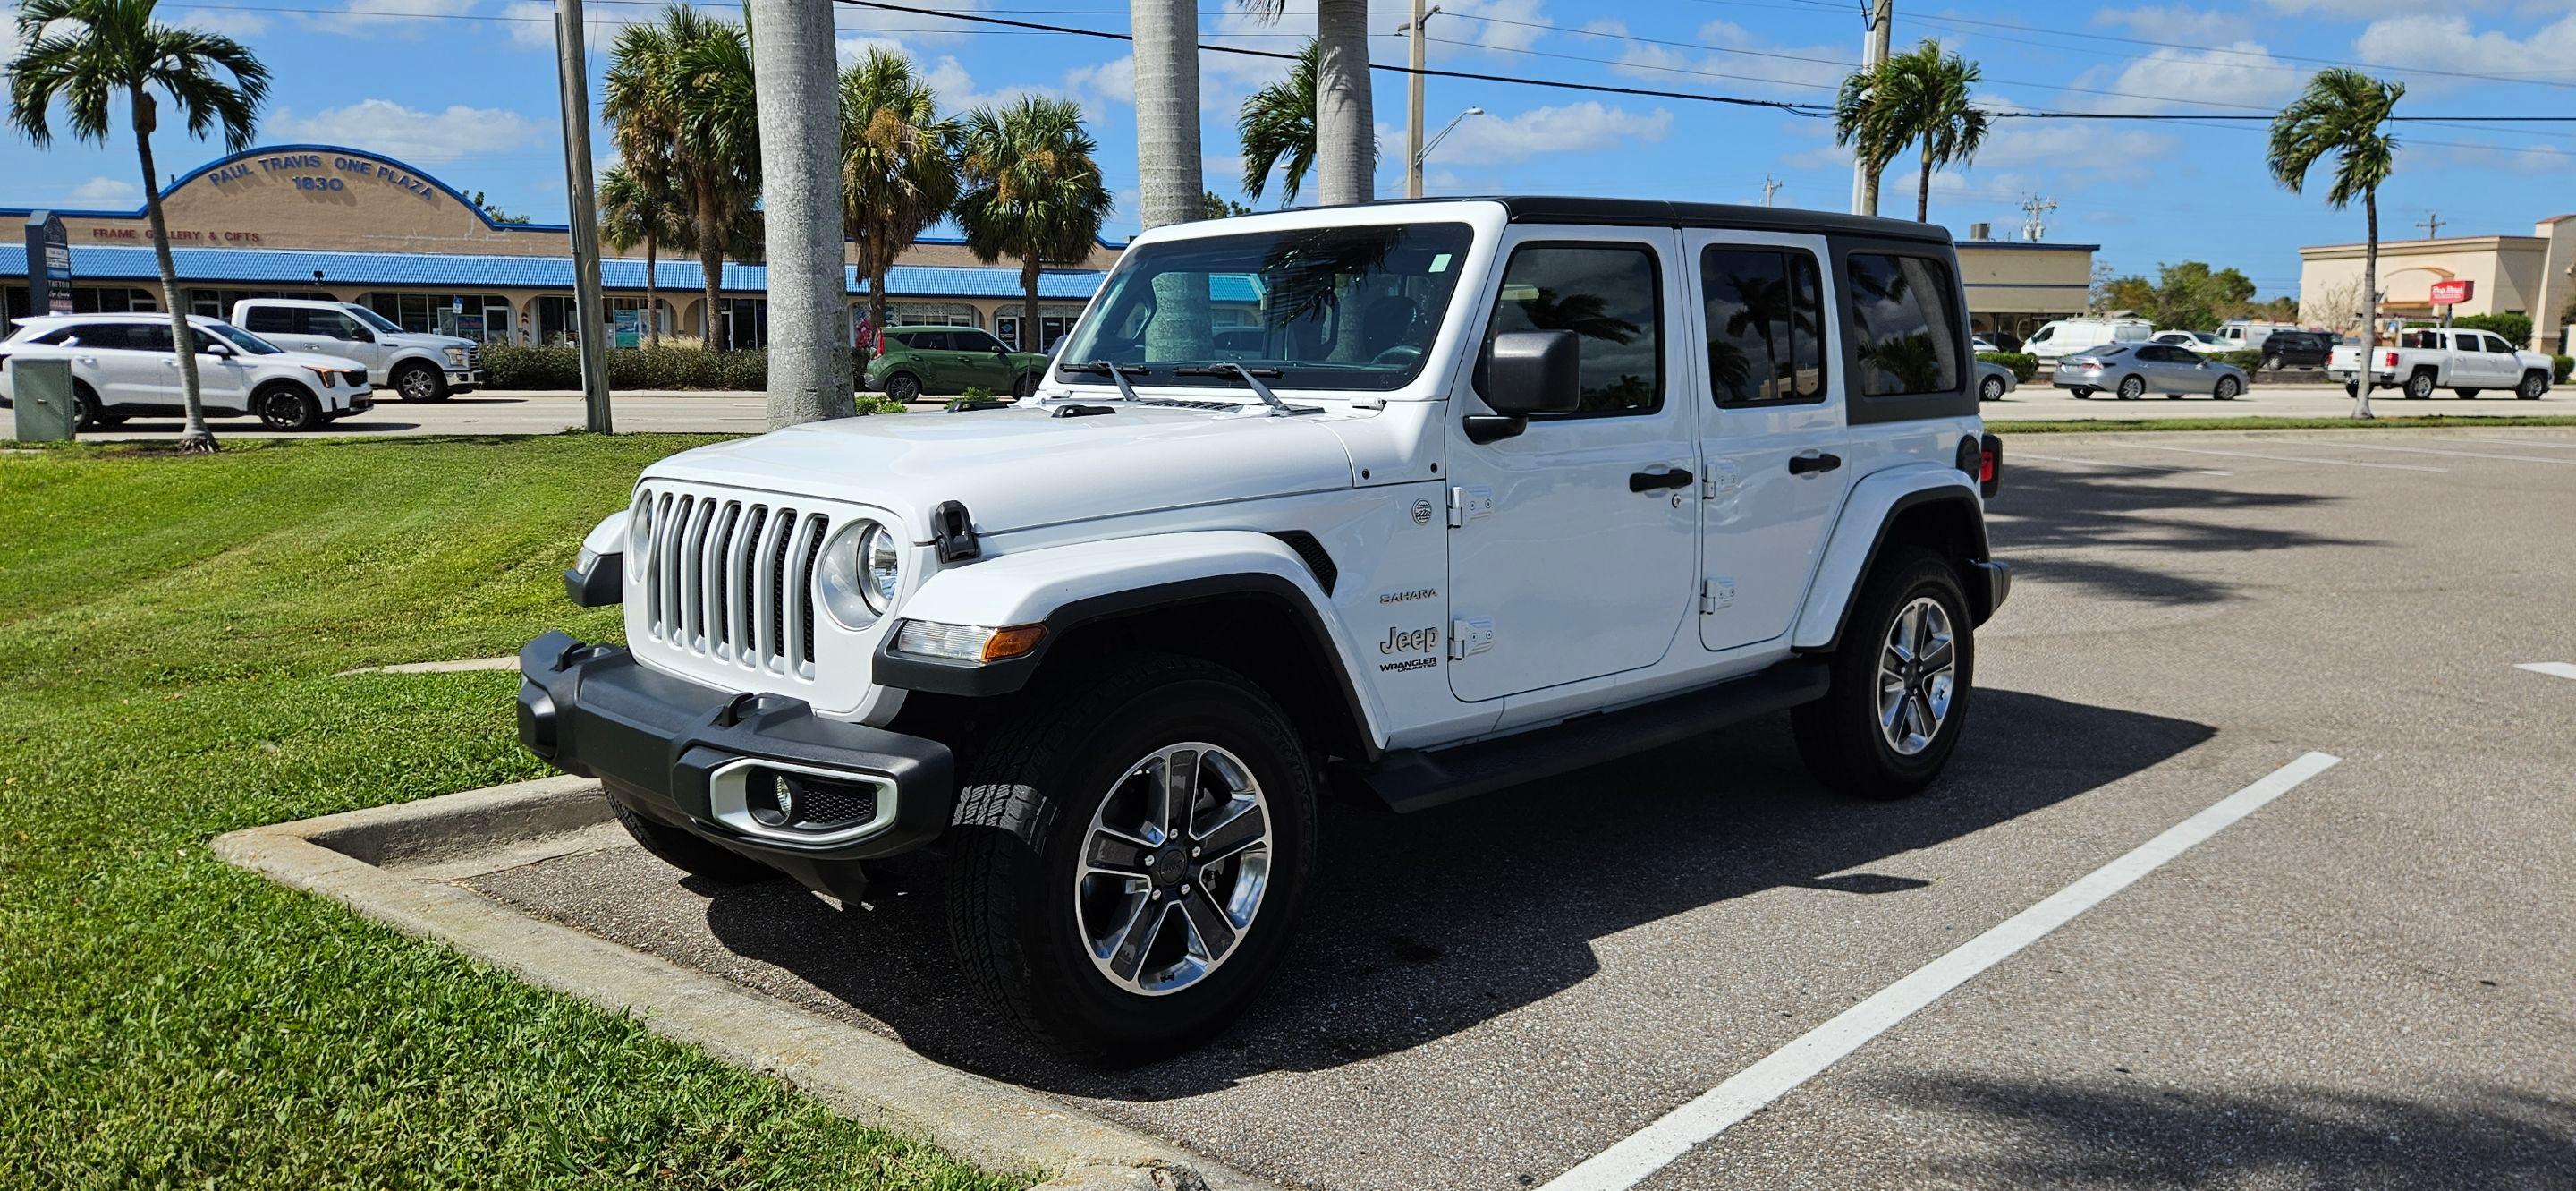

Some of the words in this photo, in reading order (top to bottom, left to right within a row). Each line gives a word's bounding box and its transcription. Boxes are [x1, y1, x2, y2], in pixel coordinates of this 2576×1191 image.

[208, 163, 253, 186] PAUL
[258, 155, 321, 174] TRAVIS
[334, 157, 371, 175] ONE
[377, 166, 434, 201] PLAZA
[292, 175, 343, 191] 1830
[93, 228, 136, 239] FRAME
[145, 229, 200, 241] GLERY
[208, 231, 216, 241] &
[224, 231, 260, 242] GIFTS
[1379, 588, 1438, 604] SAHARA
[1379, 626, 1439, 655] Jeep
[1379, 657, 1437, 672] WRANGLER
[1397, 662, 1438, 673] UNLIMITED
